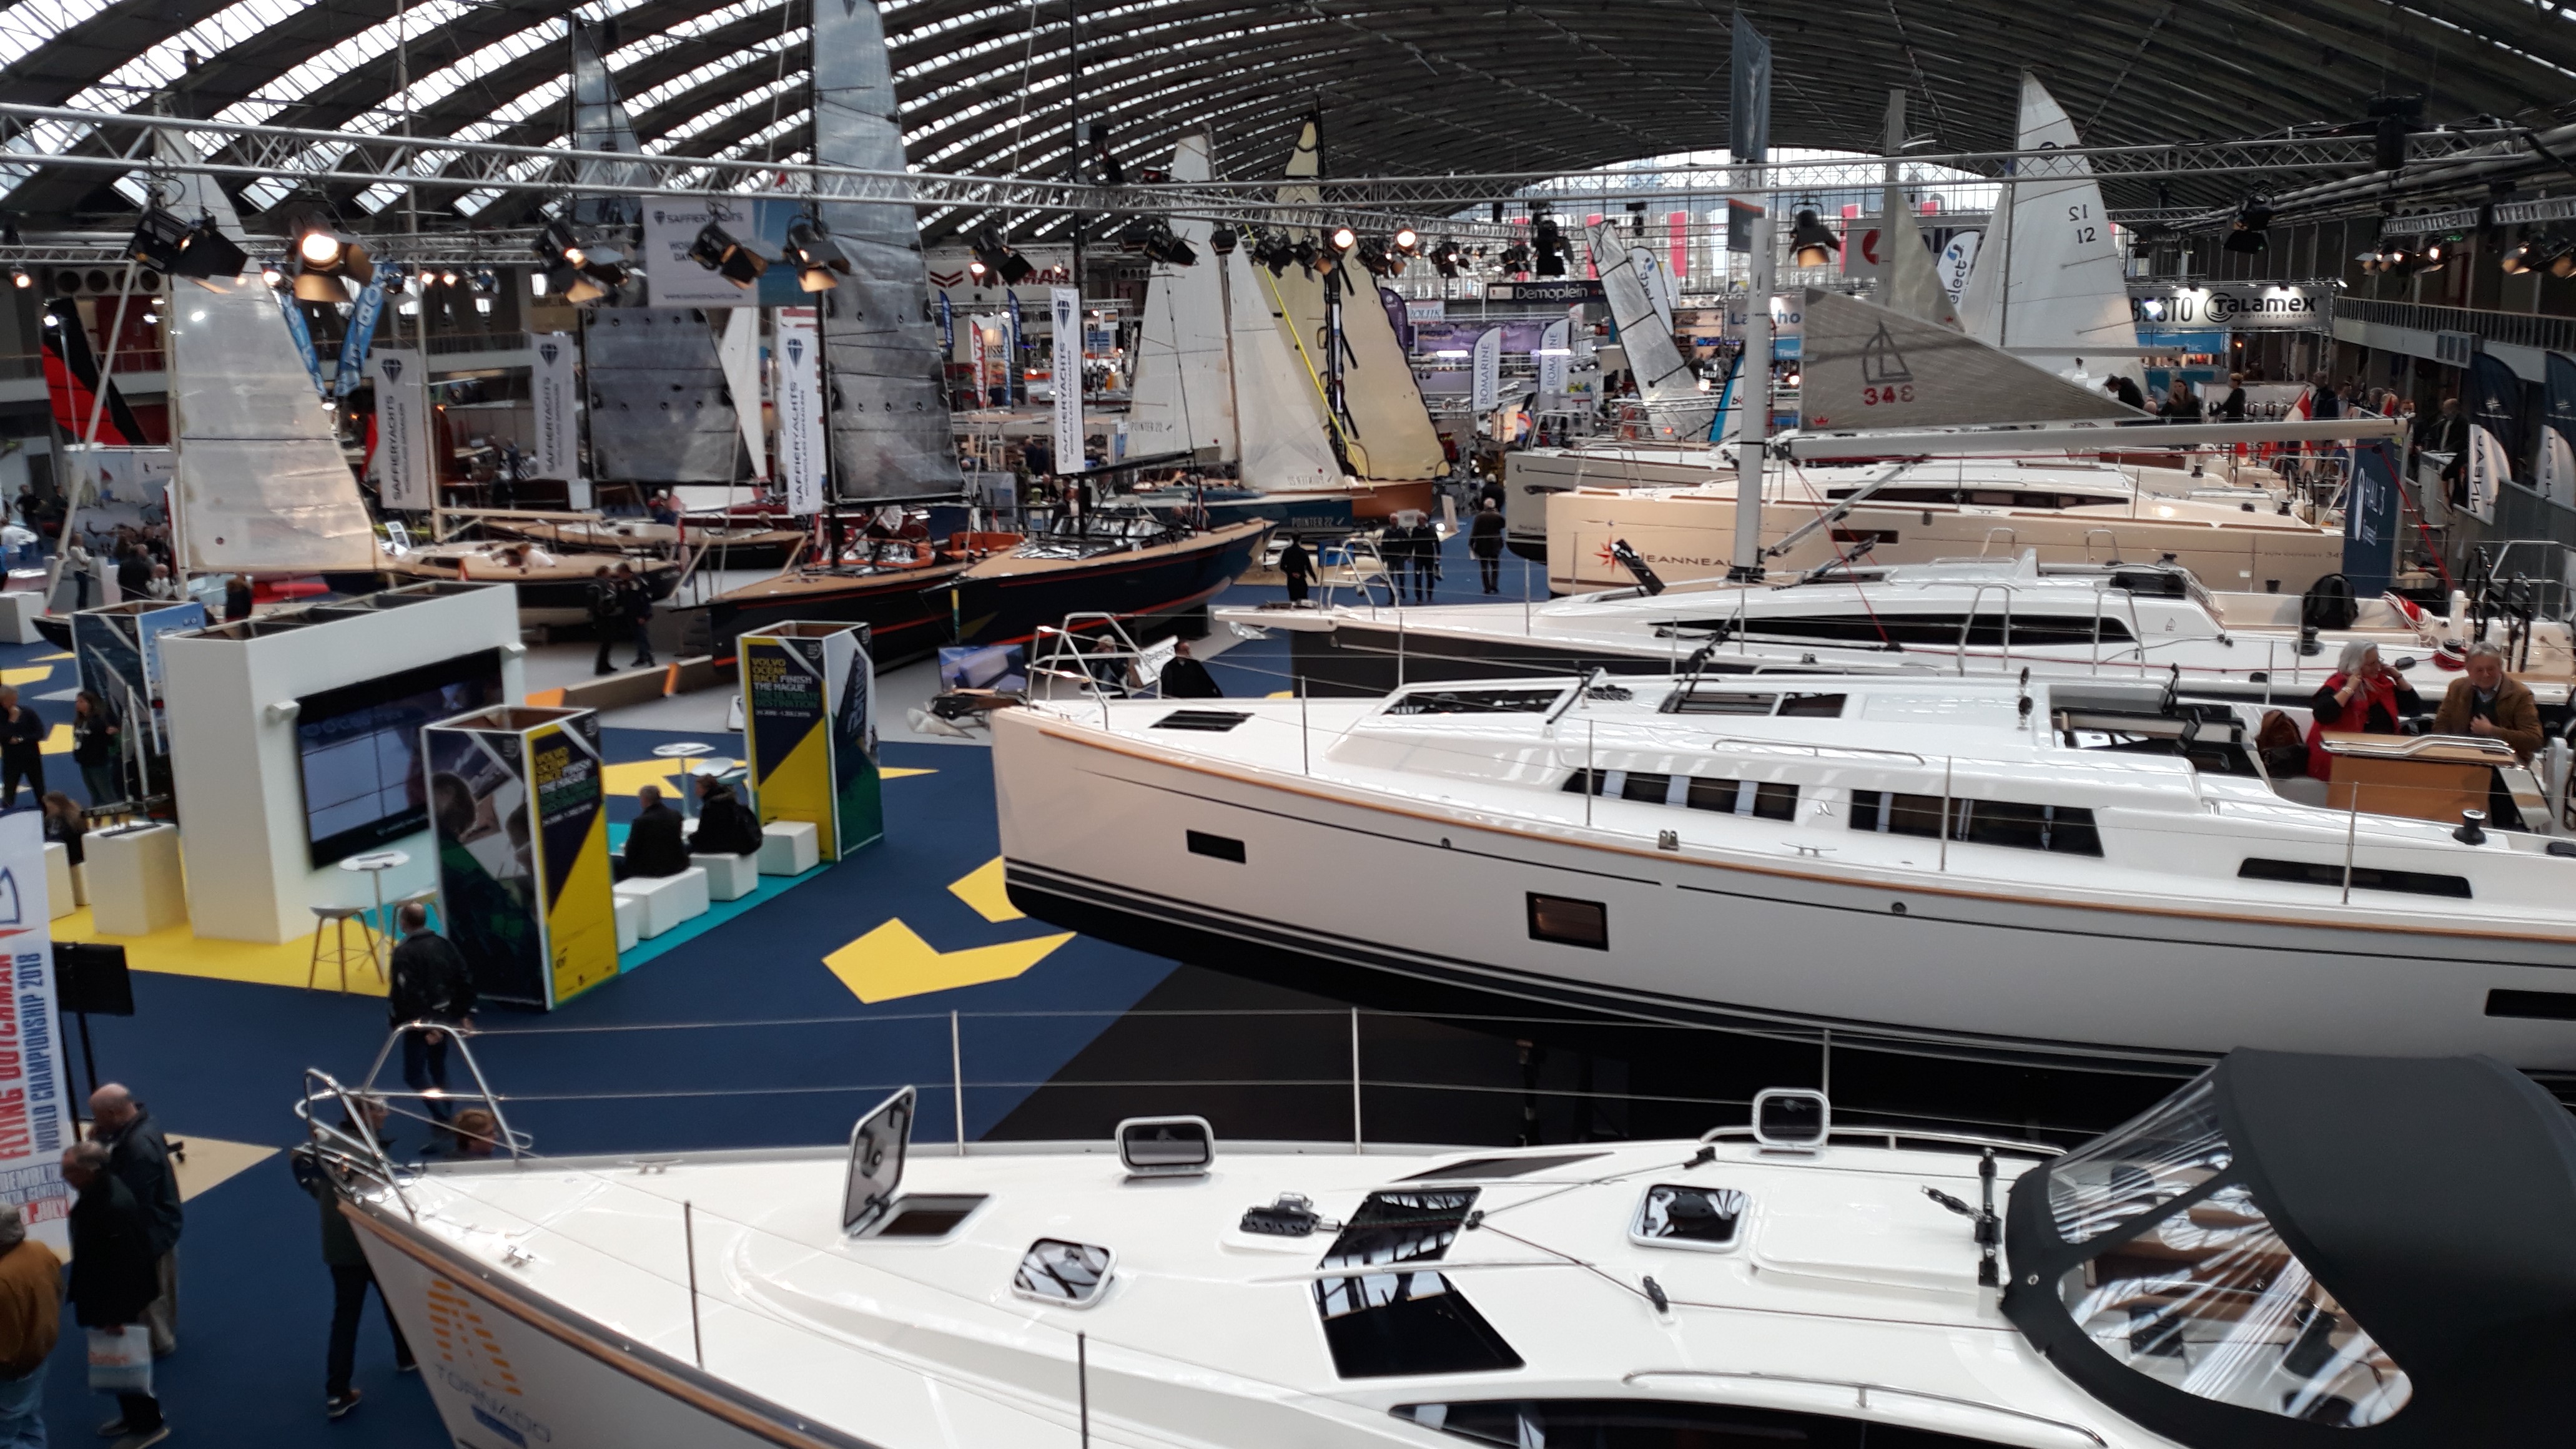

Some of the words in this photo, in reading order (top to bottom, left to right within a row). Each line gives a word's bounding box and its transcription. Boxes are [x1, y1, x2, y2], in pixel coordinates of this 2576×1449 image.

[2076, 227, 2096, 244] 12
[970, 268, 1070, 287] YAMAR
[1516, 283, 1588, 302] Demoplein
[1479, 343, 1490, 405] BOMARINE
[1546, 332, 1558, 386] BOMAINE
[1060, 341, 1068, 464] SAFFIERYACHTS
[789, 381, 803, 505] SAFFIERYACHTS
[751, 658, 786, 667] VOLVO
[780, 675, 812, 684] FINISH
[754, 682, 773, 691] THE
[774, 683, 806, 692] HAGUE
[16, 953, 44, 990] 2018
[19, 994, 55, 1103] CHAMPIONSHIP
[32, 1103, 61, 1153] WORLD
